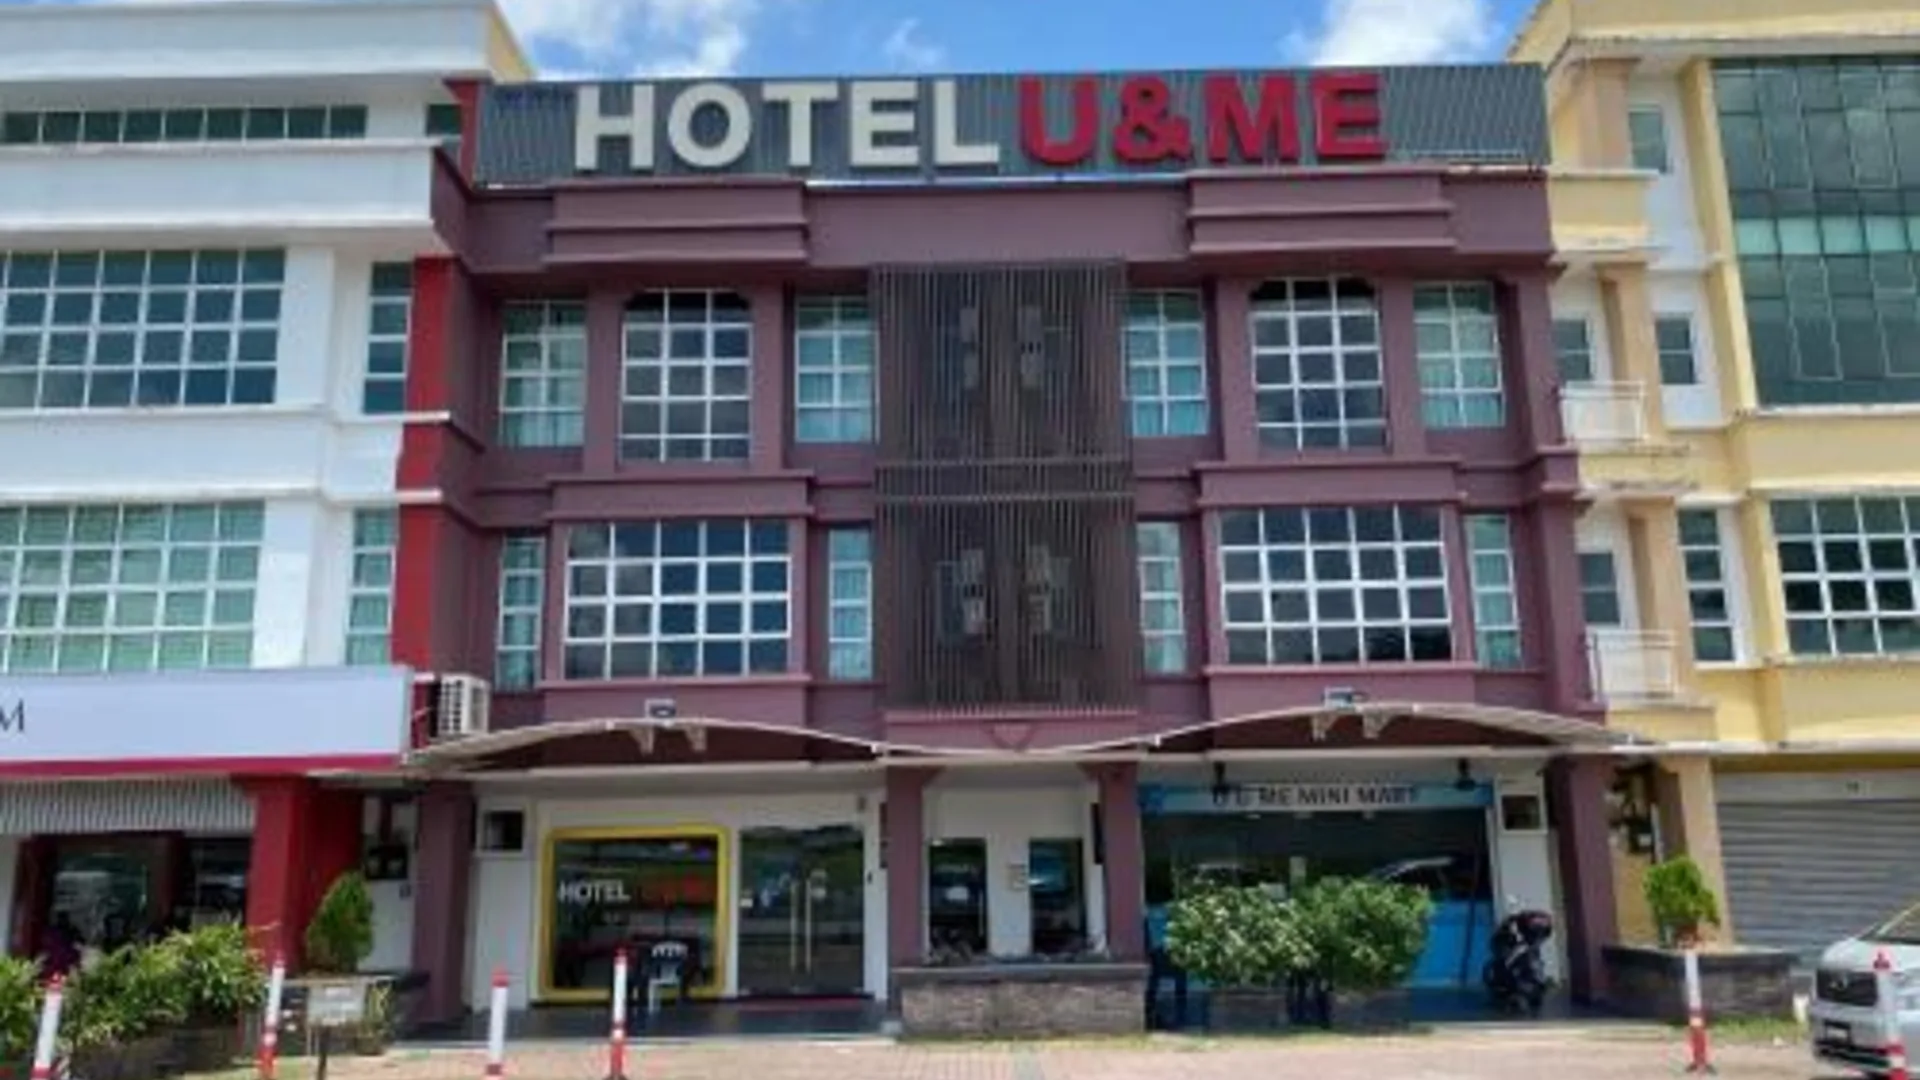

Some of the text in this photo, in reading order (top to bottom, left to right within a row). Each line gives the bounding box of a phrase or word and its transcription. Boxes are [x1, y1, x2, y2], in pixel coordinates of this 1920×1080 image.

[575, 73, 1388, 168] HOTEL U&ME
[1297, 786, 1351, 805] MINI
[558, 878, 631, 904] HOTEL
